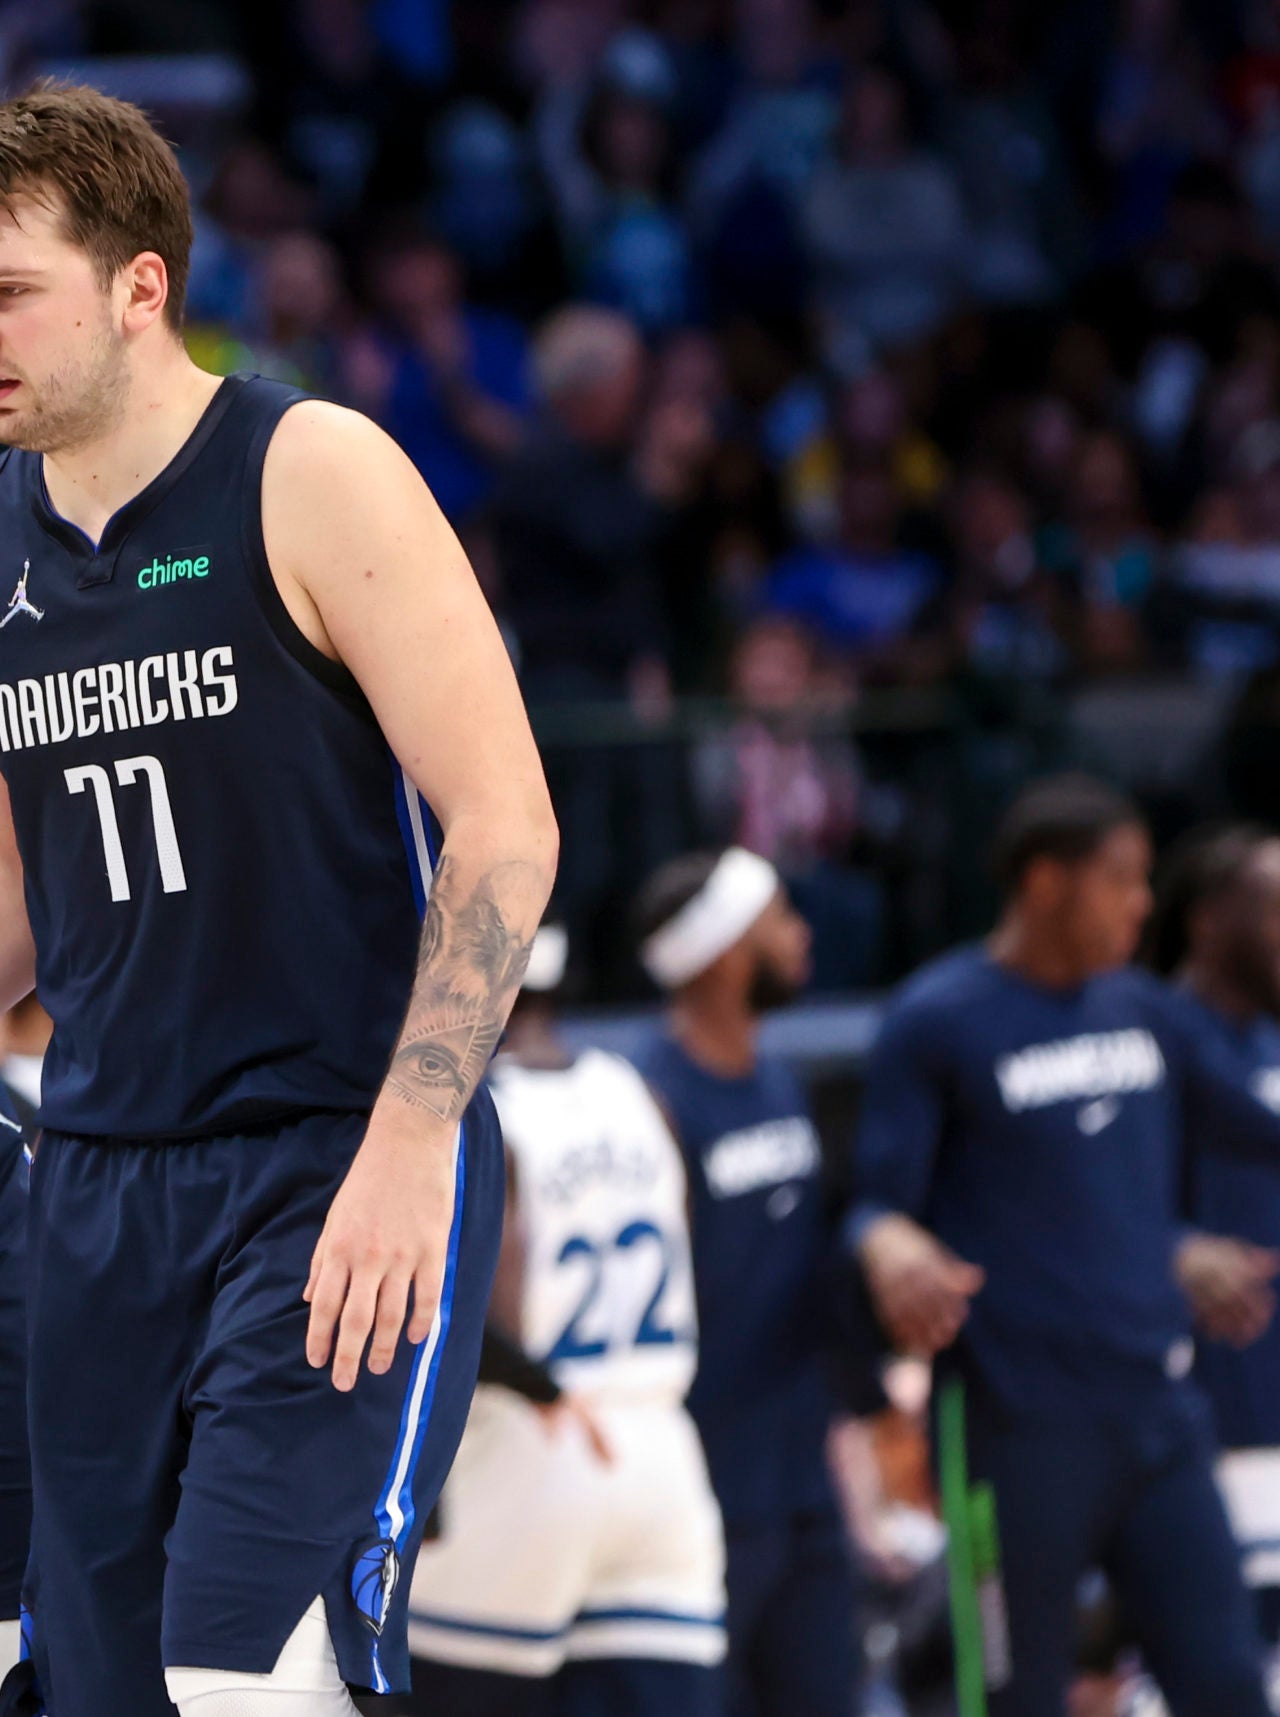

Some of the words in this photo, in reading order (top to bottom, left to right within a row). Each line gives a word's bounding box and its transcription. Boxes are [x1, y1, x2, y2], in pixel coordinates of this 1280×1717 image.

[136, 555, 210, 589] chime
[64, 756, 187, 903] 77
[548, 1218, 678, 1362] 22
